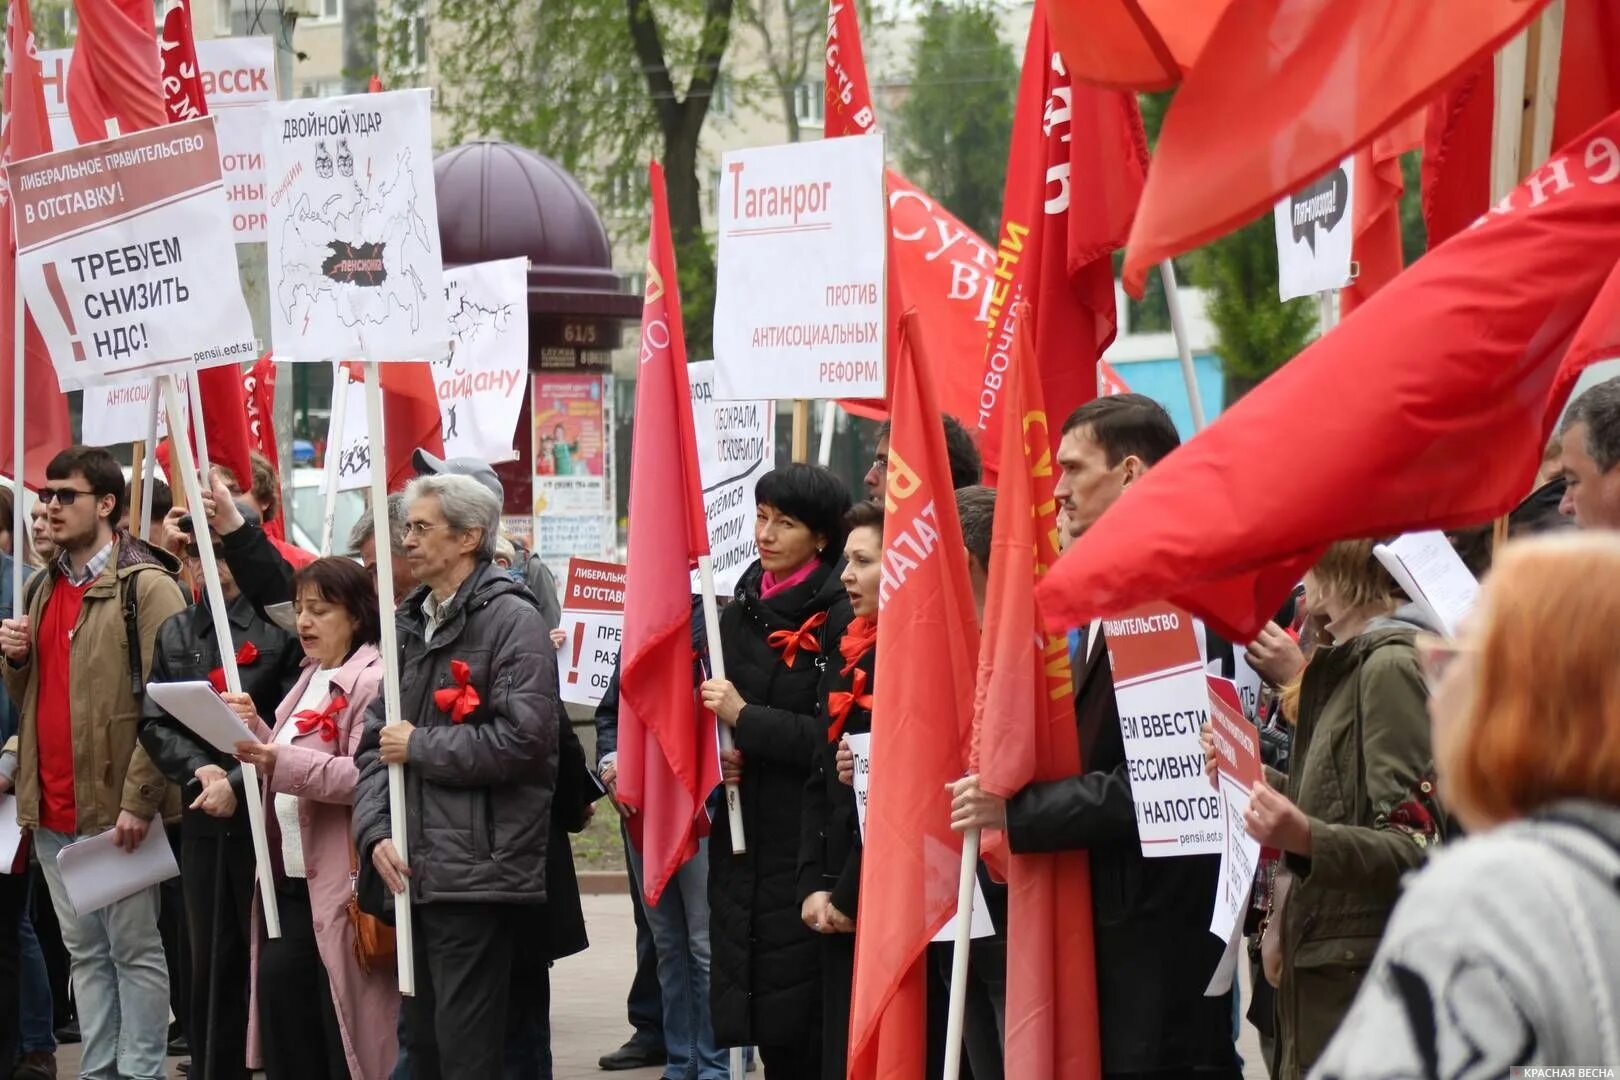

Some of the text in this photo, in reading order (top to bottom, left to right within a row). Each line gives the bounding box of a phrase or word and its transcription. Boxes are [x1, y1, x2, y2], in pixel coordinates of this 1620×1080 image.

[283, 110, 382, 144] ДВОЙНОЙ УДАР
[20, 135, 204, 192] ЛИБЕРАЛЬНОЕ ПРАВИТЕЛЬСТВО
[222, 154, 265, 173] ОТИ
[25, 181, 125, 224] В ОТСТАВКУ!
[729, 161, 831, 224] Таганрог
[71, 236, 182, 283] ТРЕБУЕМ
[84, 277, 189, 320] СНИЗИТЬ
[826, 284, 877, 306] ПРОТИВ
[93, 323, 149, 360] НДС!
[565, 325, 595, 342] 61/5
[752, 322, 877, 350] АНТИСОЦИАЛЬНЫХ
[193, 340, 253, 364] pensii.eot.su
[820, 361, 877, 382] РЕФОРМ
[573, 585, 581, 597] В
[1141, 709, 1208, 738] ВВЕСТИ
